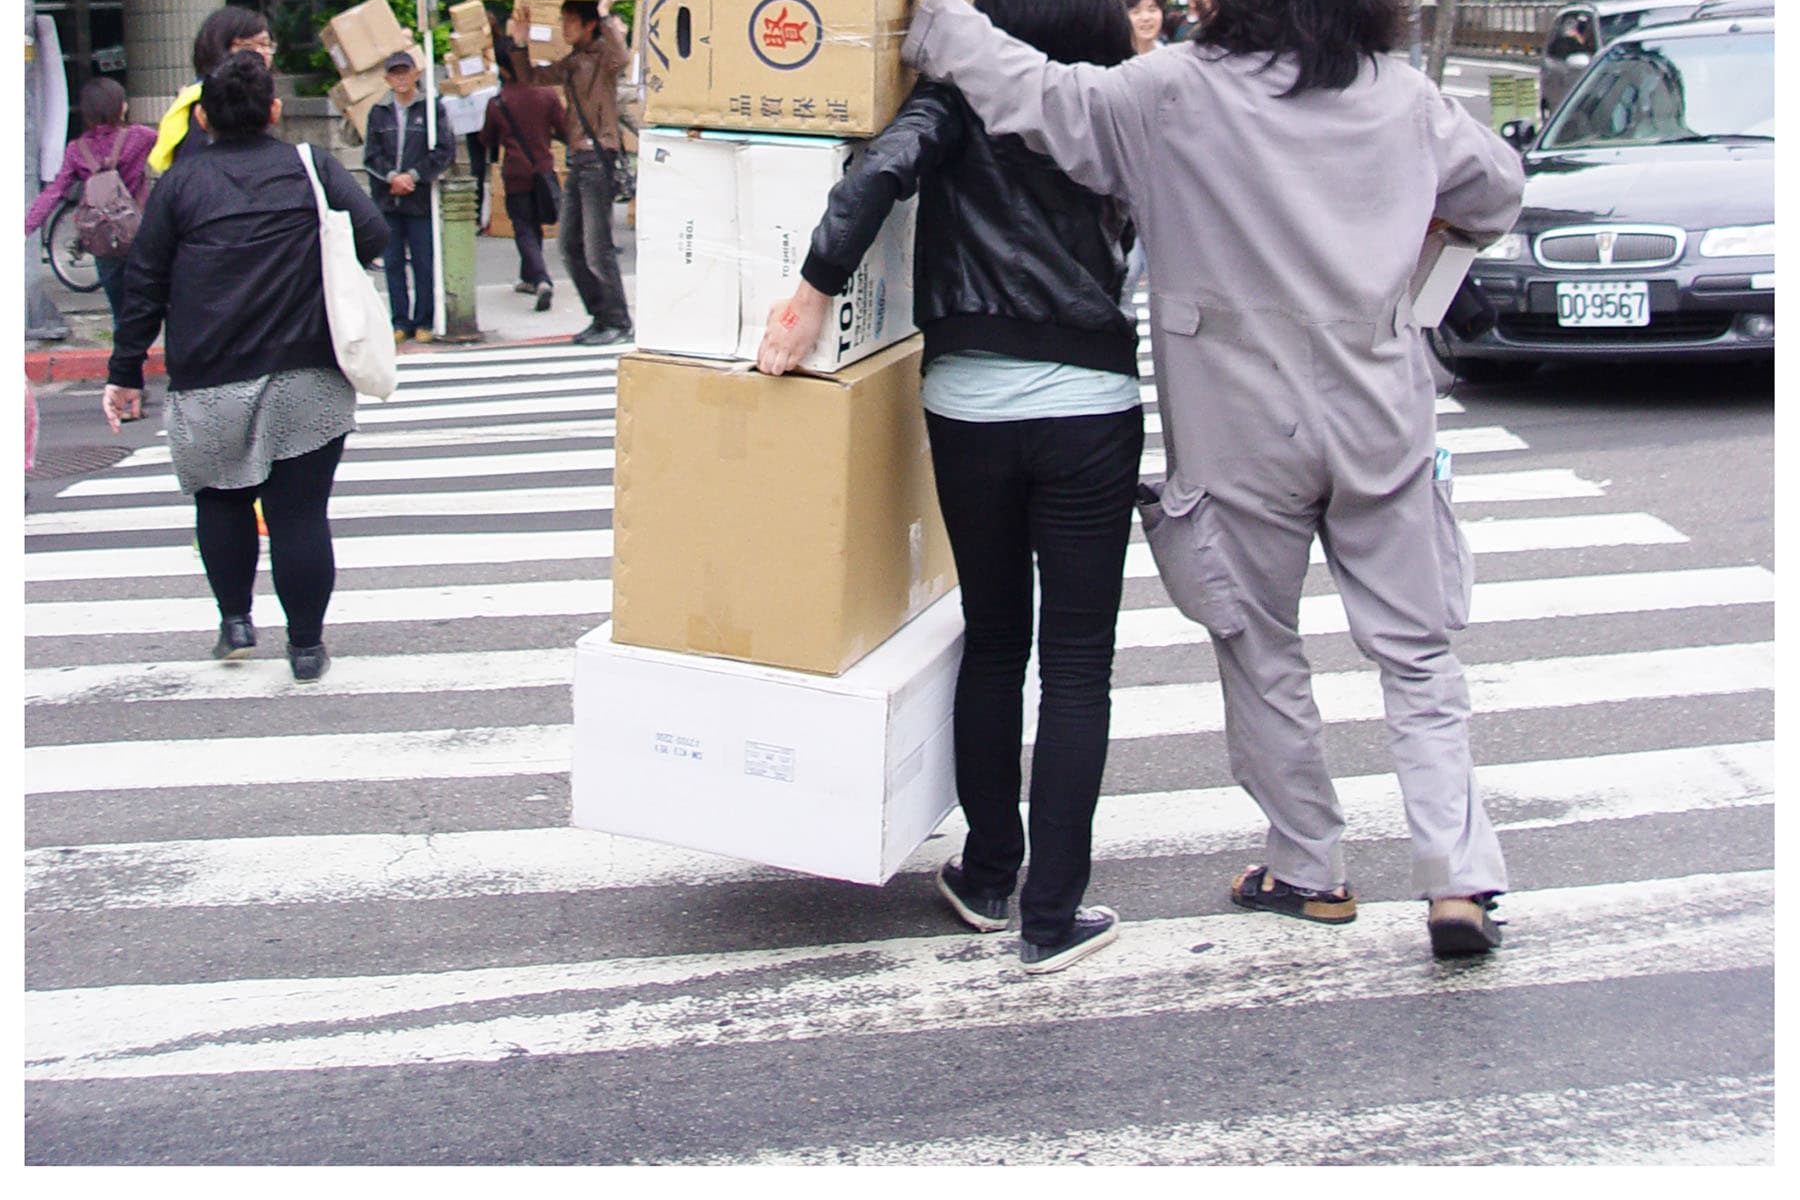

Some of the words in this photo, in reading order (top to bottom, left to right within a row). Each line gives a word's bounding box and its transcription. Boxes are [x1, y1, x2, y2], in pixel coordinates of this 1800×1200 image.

[762, 6, 808, 49] 賢
[685, 219, 694, 265] TOSHIBA
[782, 232, 790, 278] TOSHIBA
